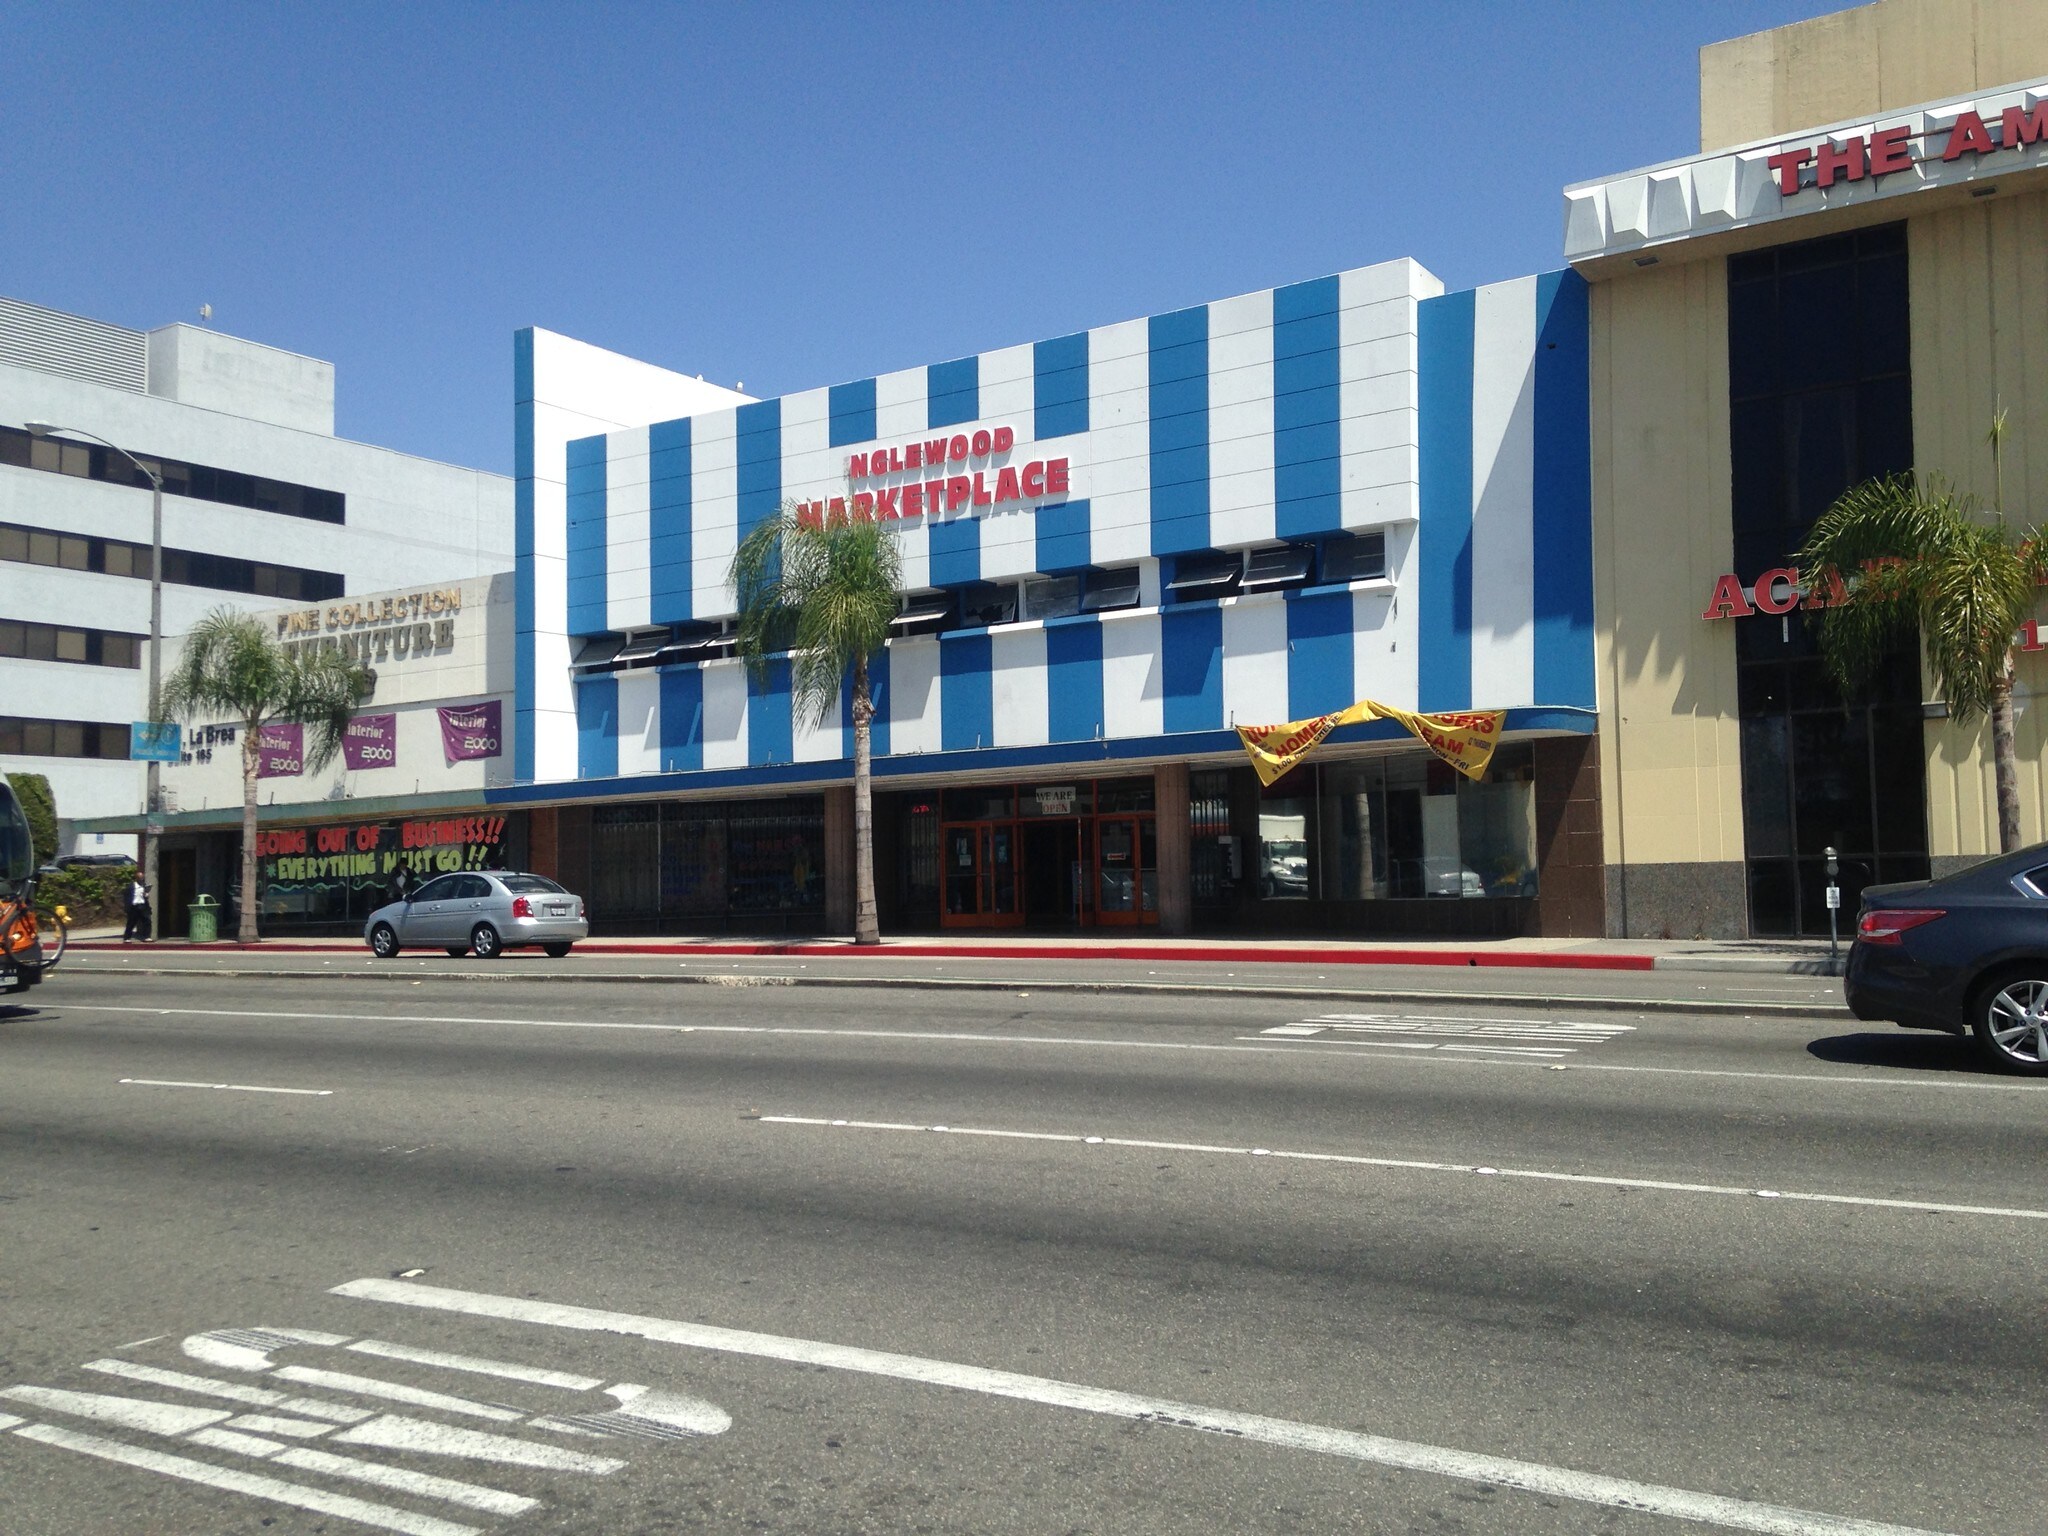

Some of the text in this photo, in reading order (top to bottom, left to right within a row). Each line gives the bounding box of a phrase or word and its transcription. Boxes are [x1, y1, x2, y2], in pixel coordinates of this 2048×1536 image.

[1768, 124, 1913, 197] THE
[849, 426, 1014, 480] NGLEWOOD
[797, 457, 1069, 533] MARKETPLACE
[277, 587, 462, 640] FINE COLLECTION
[190, 728, 203, 746] La
[206, 725, 236, 744] Brea
[464, 736, 498, 751] 2000
[1414, 718, 1465, 755] EAM
[269, 757, 300, 772] 2000
[361, 745, 393, 761] 2000
[1271, 757, 1293, 775] $1.00
[1036, 790, 1073, 801] WE ARE
[1043, 803, 1068, 813] OPEN
[256, 829, 306, 857] GOING
[317, 826, 348, 853] OUT
[356, 825, 380, 851] OF
[278, 852, 377, 881] EVERYTHING
